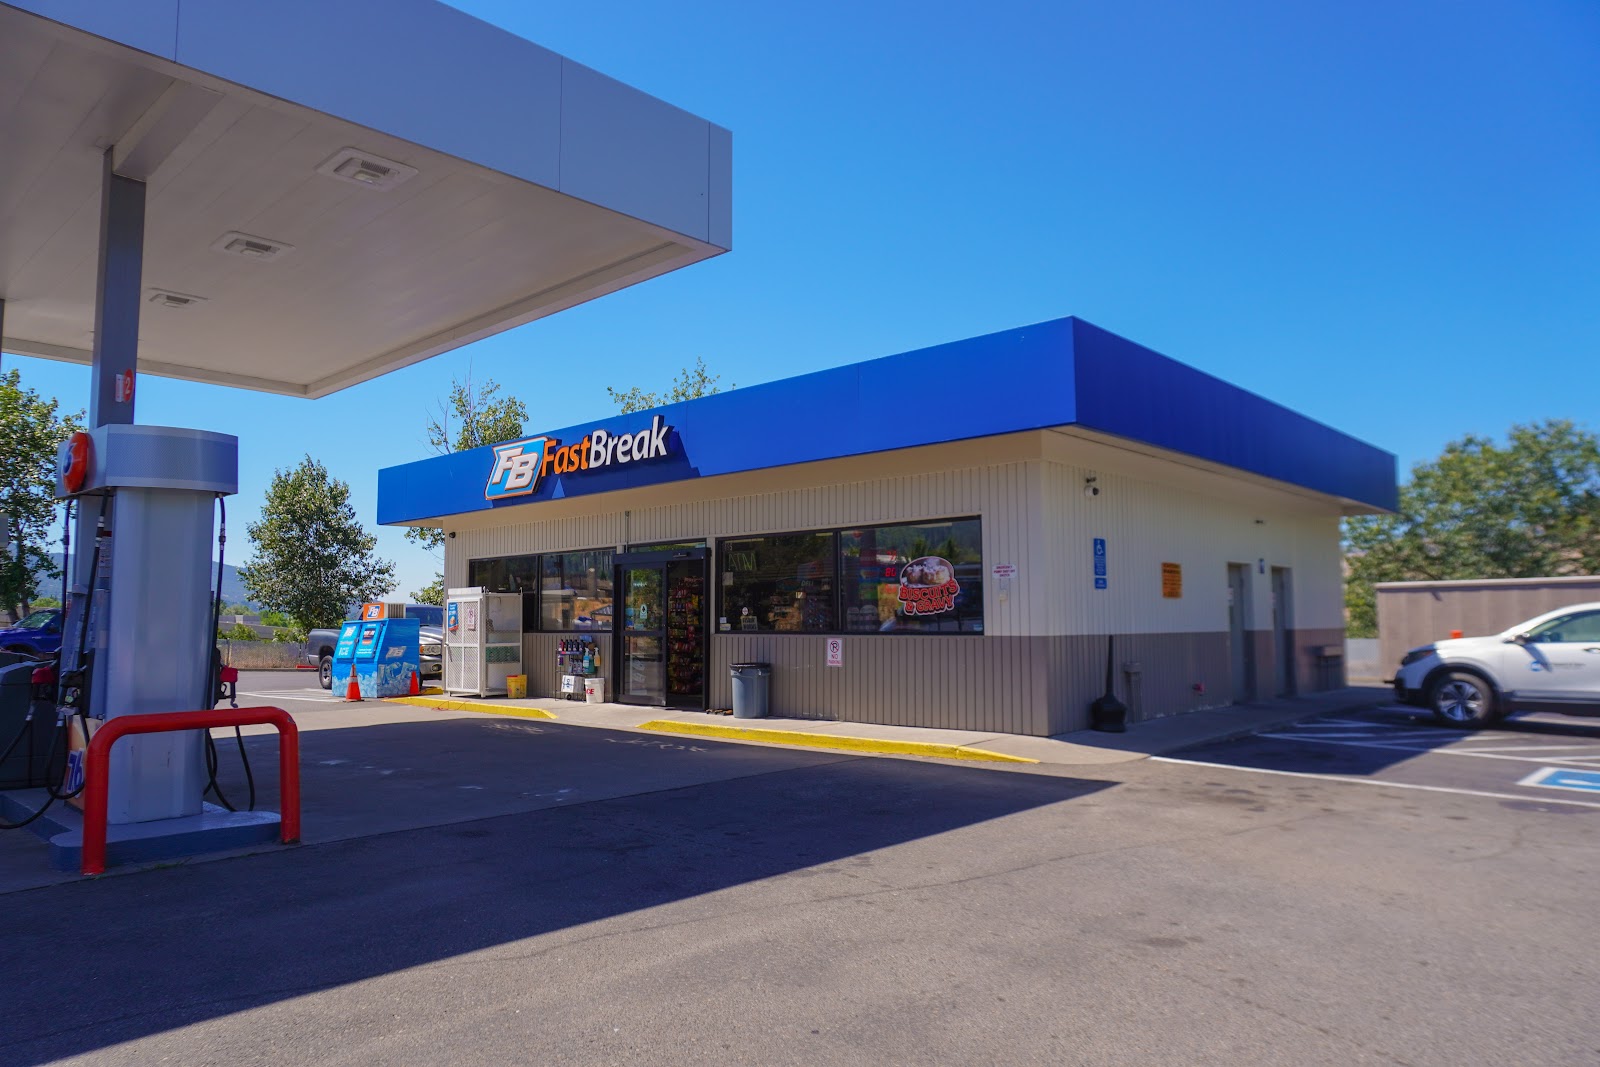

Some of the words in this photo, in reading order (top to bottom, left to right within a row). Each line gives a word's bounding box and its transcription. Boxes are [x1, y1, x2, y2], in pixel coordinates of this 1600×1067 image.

[125, 377, 131, 394] 2
[492, 447, 539, 491] FB
[541, 415, 671, 477] FastBreak
[728, 552, 757, 571] ATM
[899, 580, 957, 600] BISCUITS
[905, 601, 914, 612] &
[916, 595, 954, 612] GRAVY
[66, 748, 84, 798] 76
